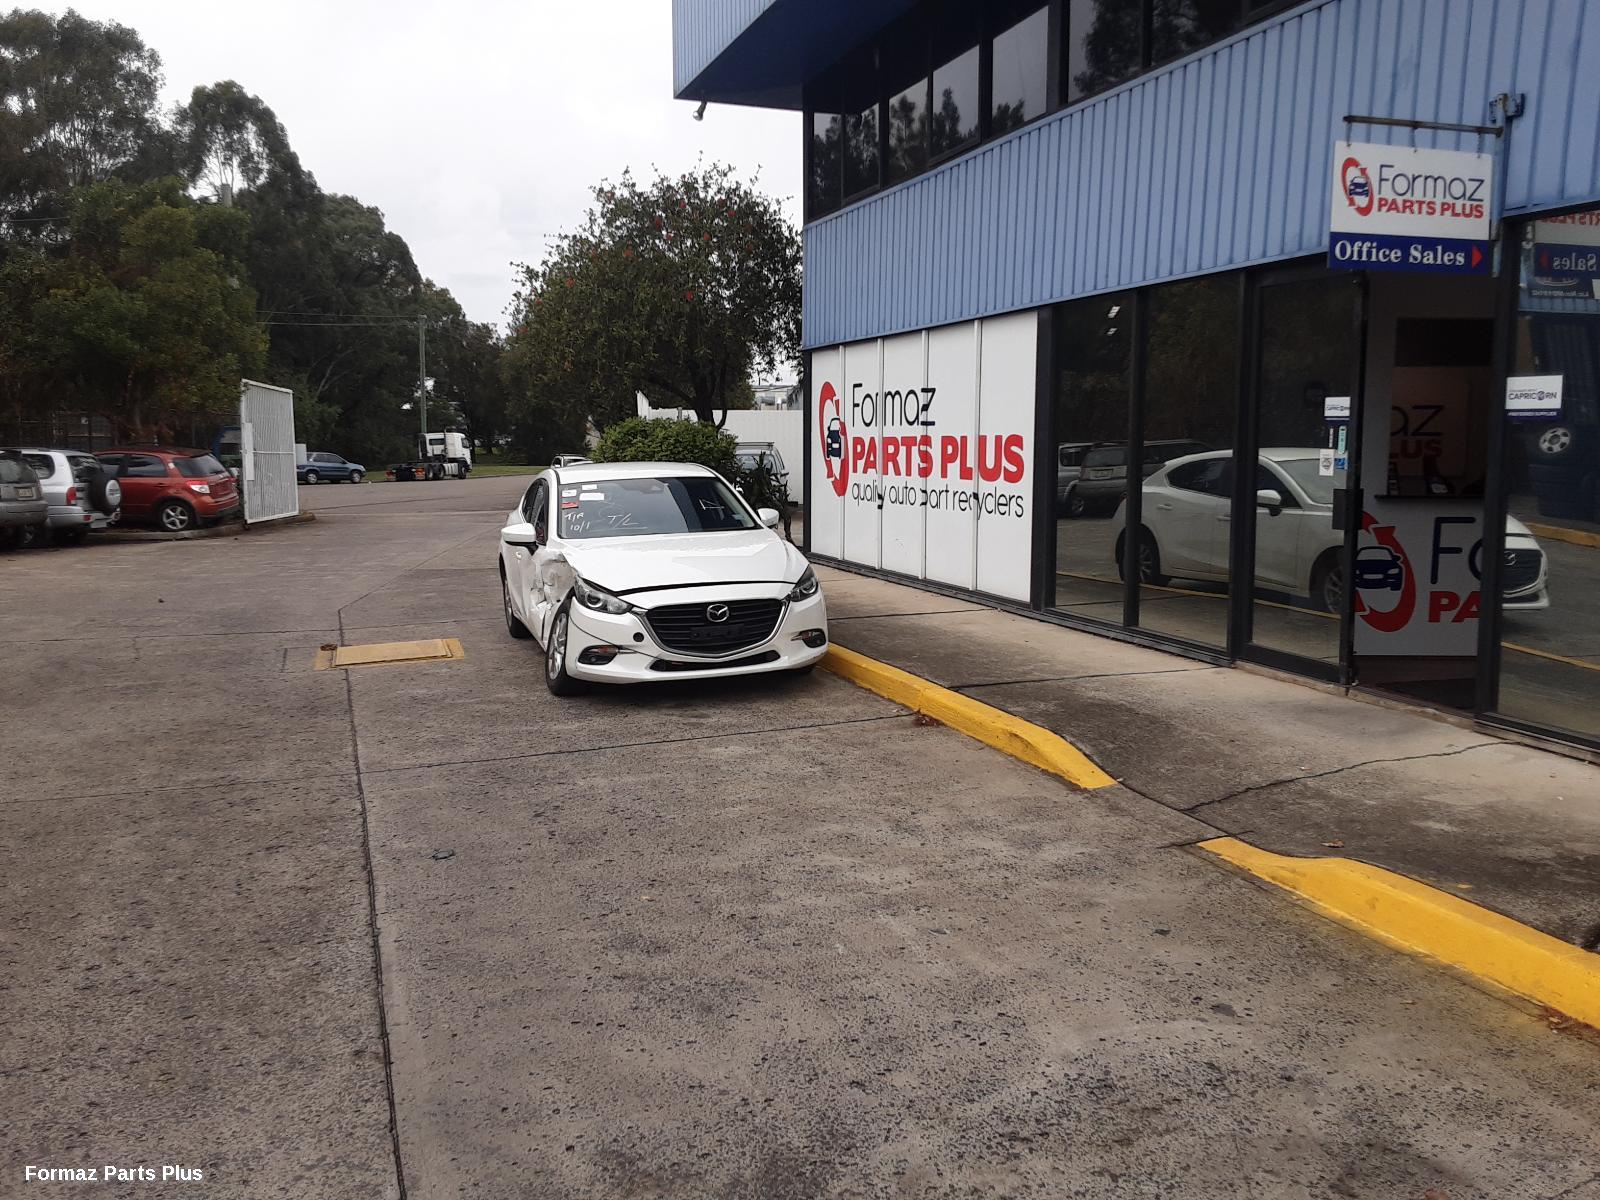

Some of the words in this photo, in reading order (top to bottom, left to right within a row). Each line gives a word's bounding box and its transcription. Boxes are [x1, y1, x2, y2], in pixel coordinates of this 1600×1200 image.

[1378, 164, 1485, 203] Formaz
[1377, 197, 1436, 215] PARTS
[1440, 201, 1485, 219] PLUS
[1334, 240, 1402, 262] Office
[1408, 244, 1465, 266] Sales
[852, 383, 936, 428] Formaz
[852, 434, 933, 479] PARTS
[940, 434, 1025, 484] PLUS
[852, 479, 887, 510] qualiy
[889, 480, 916, 506] auto
